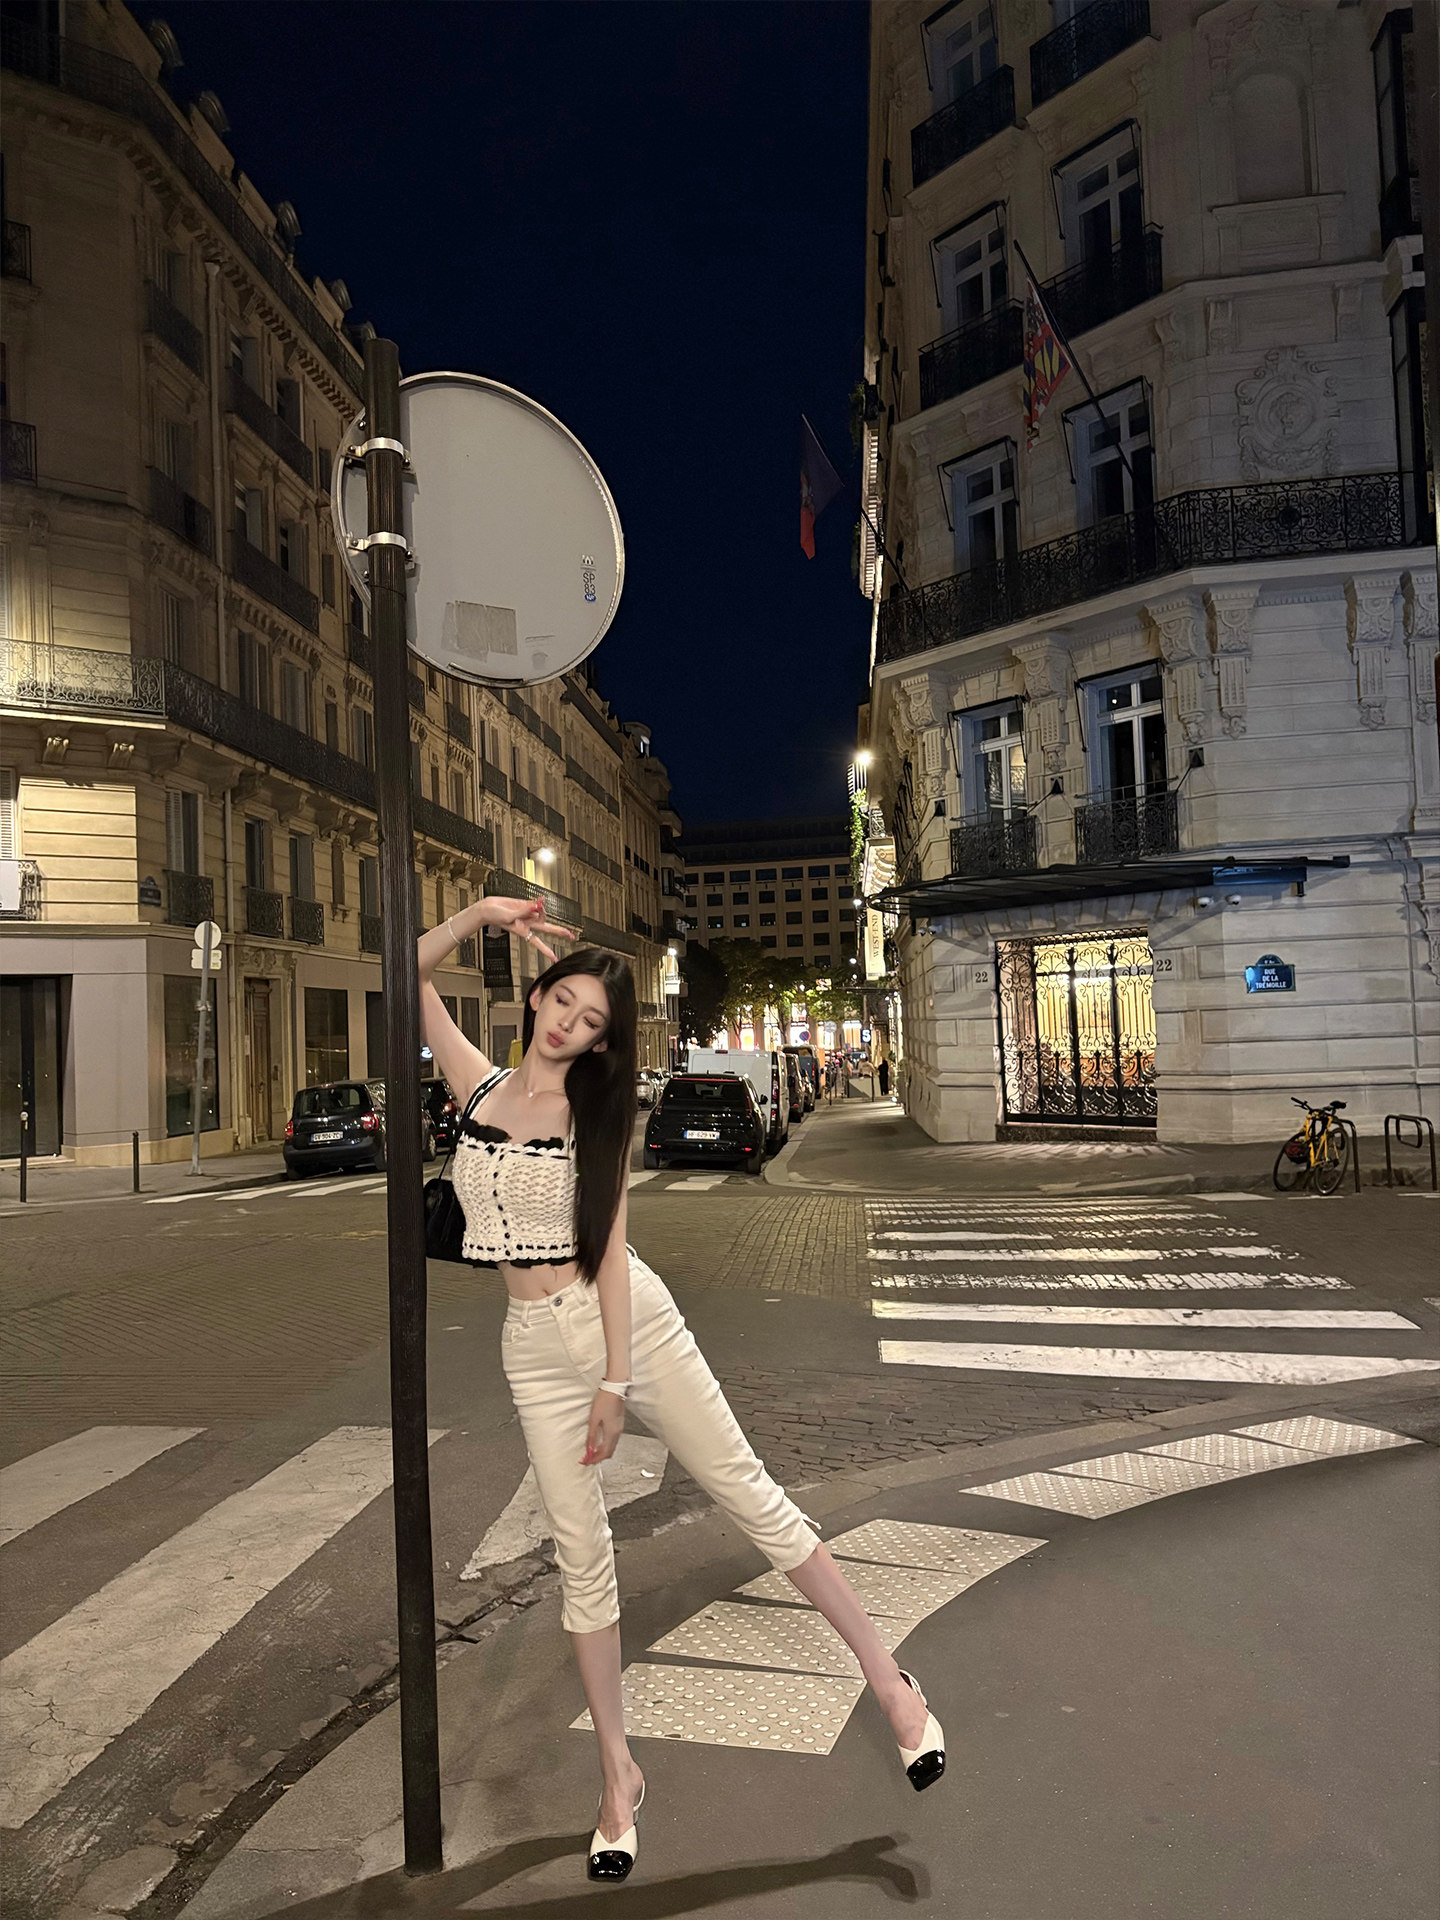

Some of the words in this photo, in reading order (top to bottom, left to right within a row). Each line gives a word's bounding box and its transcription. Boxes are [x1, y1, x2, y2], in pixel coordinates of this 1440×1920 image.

[583, 572, 595, 584] SP
[584, 583, 596, 595] 83
[872, 914, 880, 958] WEST-END
[1156, 958, 1173, 972] 22
[975, 971, 988, 983] 22
